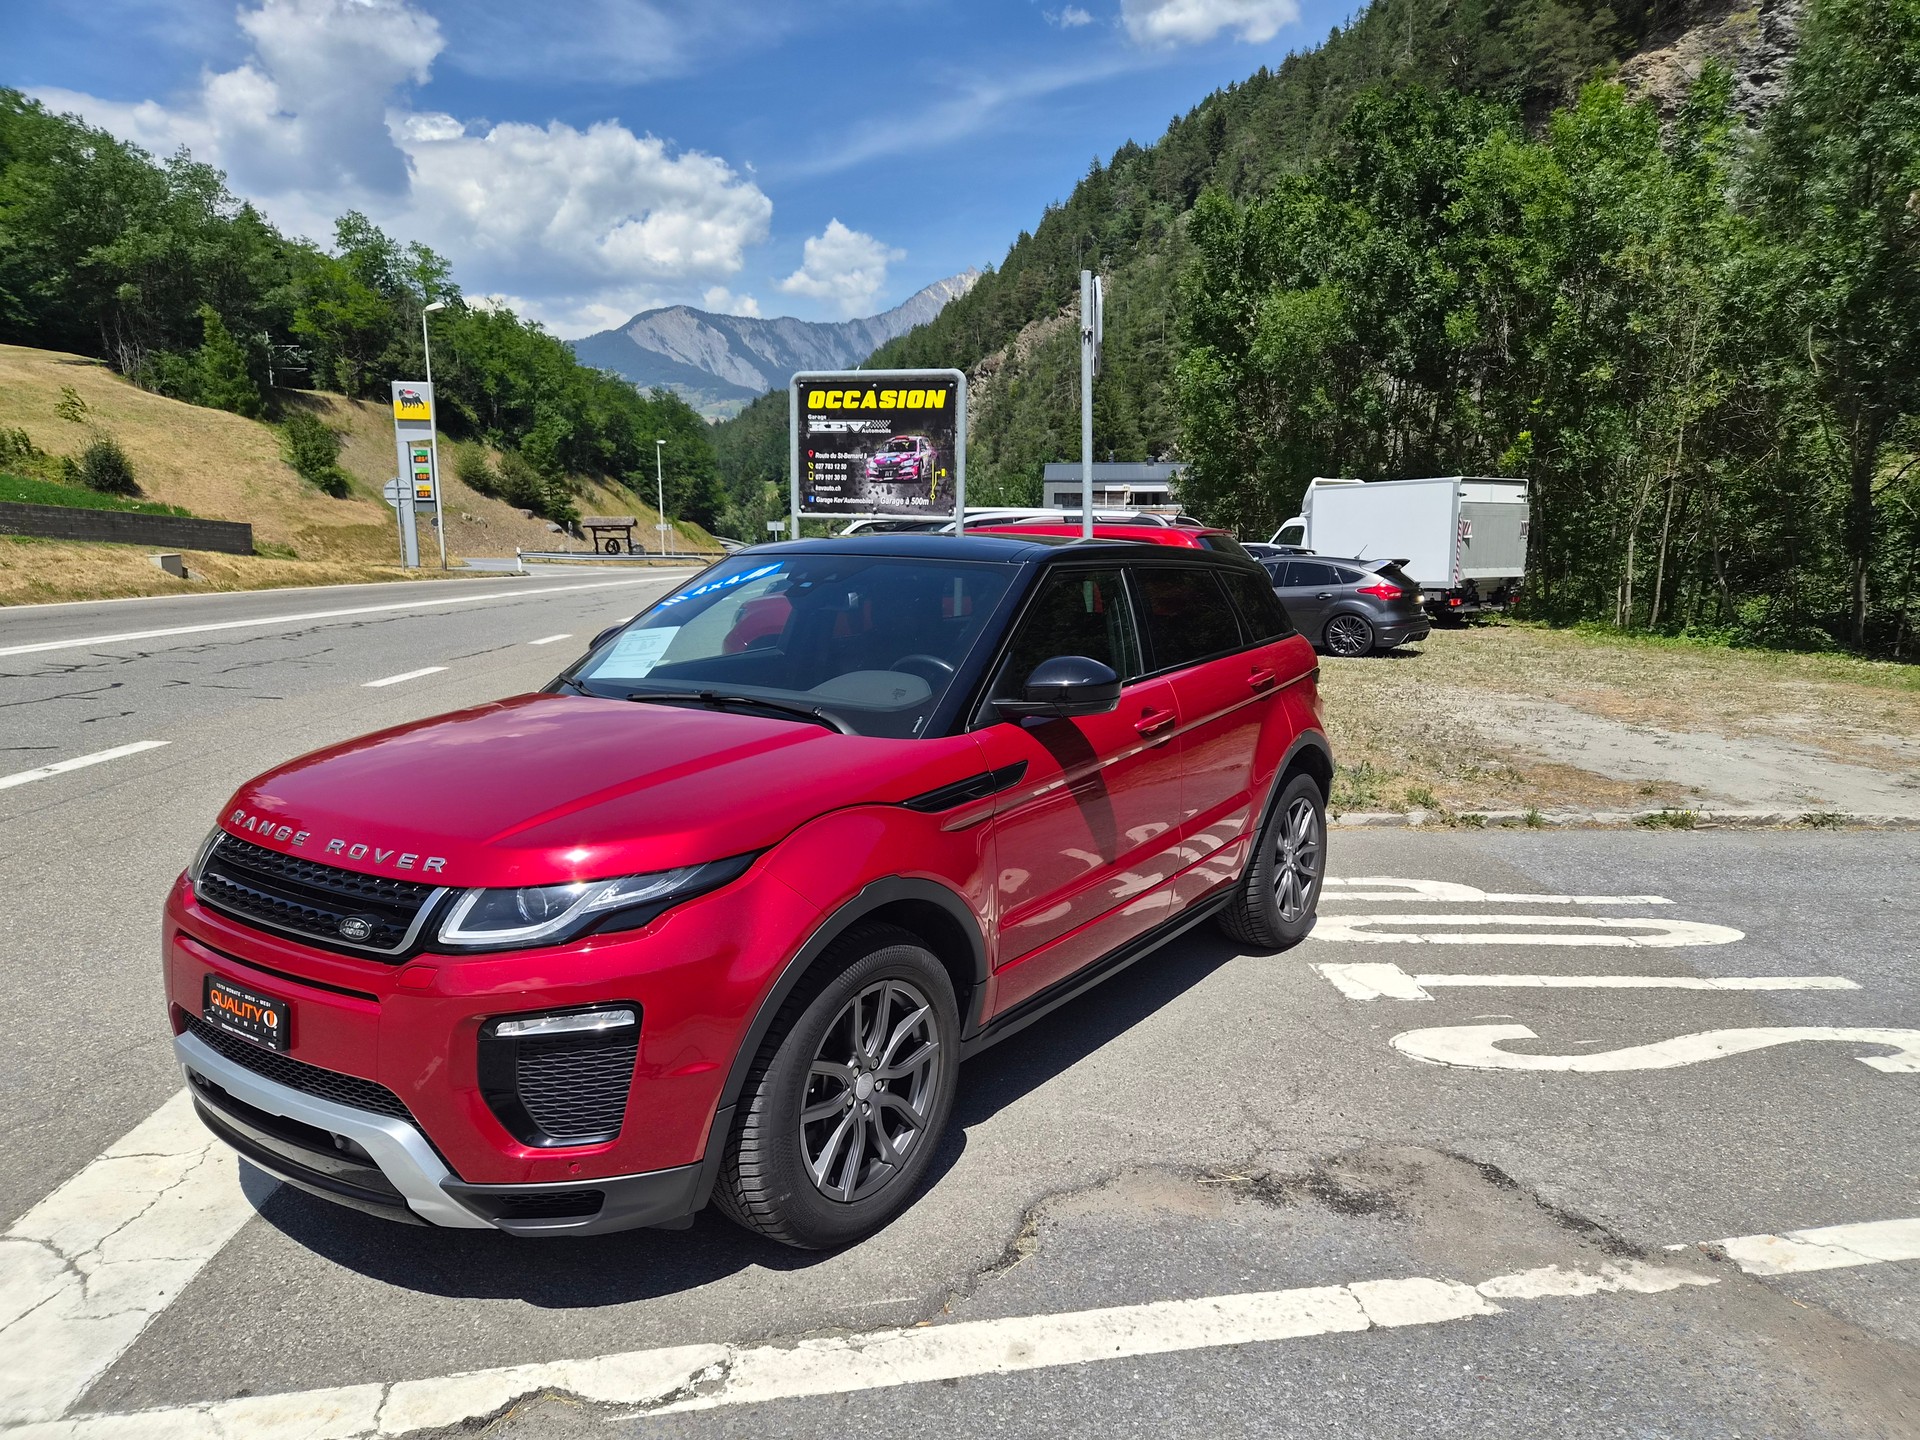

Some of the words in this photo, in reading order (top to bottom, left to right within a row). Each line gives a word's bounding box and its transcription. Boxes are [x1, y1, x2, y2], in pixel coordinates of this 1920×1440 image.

[807, 389, 947, 409] OCCASION
[816, 497, 833, 505] Garage
[880, 497, 904, 507] Garage
[904, 497, 910, 505] à
[910, 497, 930, 506] 500m
[229, 808, 311, 847] RANGE
[325, 838, 448, 873] ROVER
[345, 928, 365, 937] ROVER
[210, 989, 264, 1022] QUALITY
[211, 1005, 278, 1037] GARANTIE
